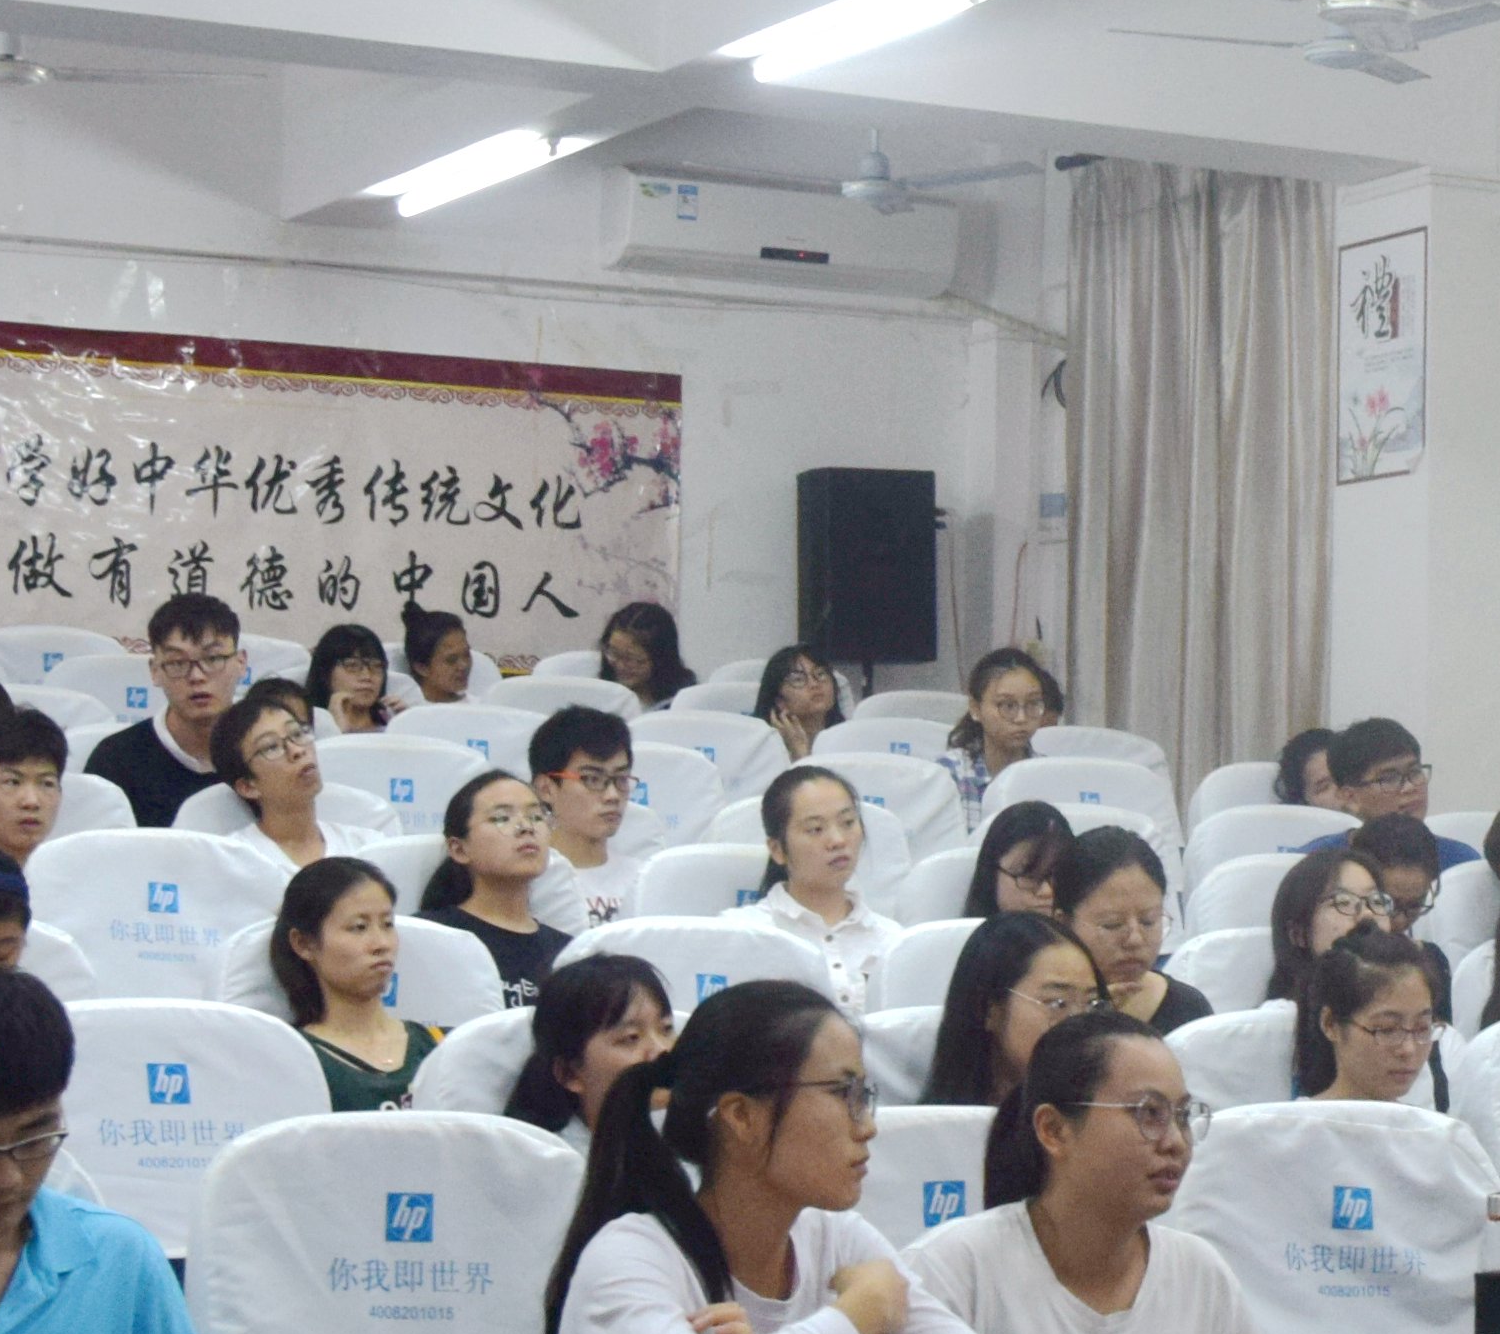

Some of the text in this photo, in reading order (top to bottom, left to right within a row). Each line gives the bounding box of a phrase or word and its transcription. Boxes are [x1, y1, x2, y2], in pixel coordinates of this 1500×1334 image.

[7, 434, 582, 530] 学好中华优秀传统文化
[8, 531, 581, 619] 做有道德的中国人
[153, 1064, 183, 1104] hp
[392, 1194, 428, 1241] hp
[930, 1181, 960, 1225] hp
[1341, 1187, 1367, 1229] hp
[328, 1258, 493, 1294] 你我即世界
[1285, 1243, 1427, 1276] 你我即世界
